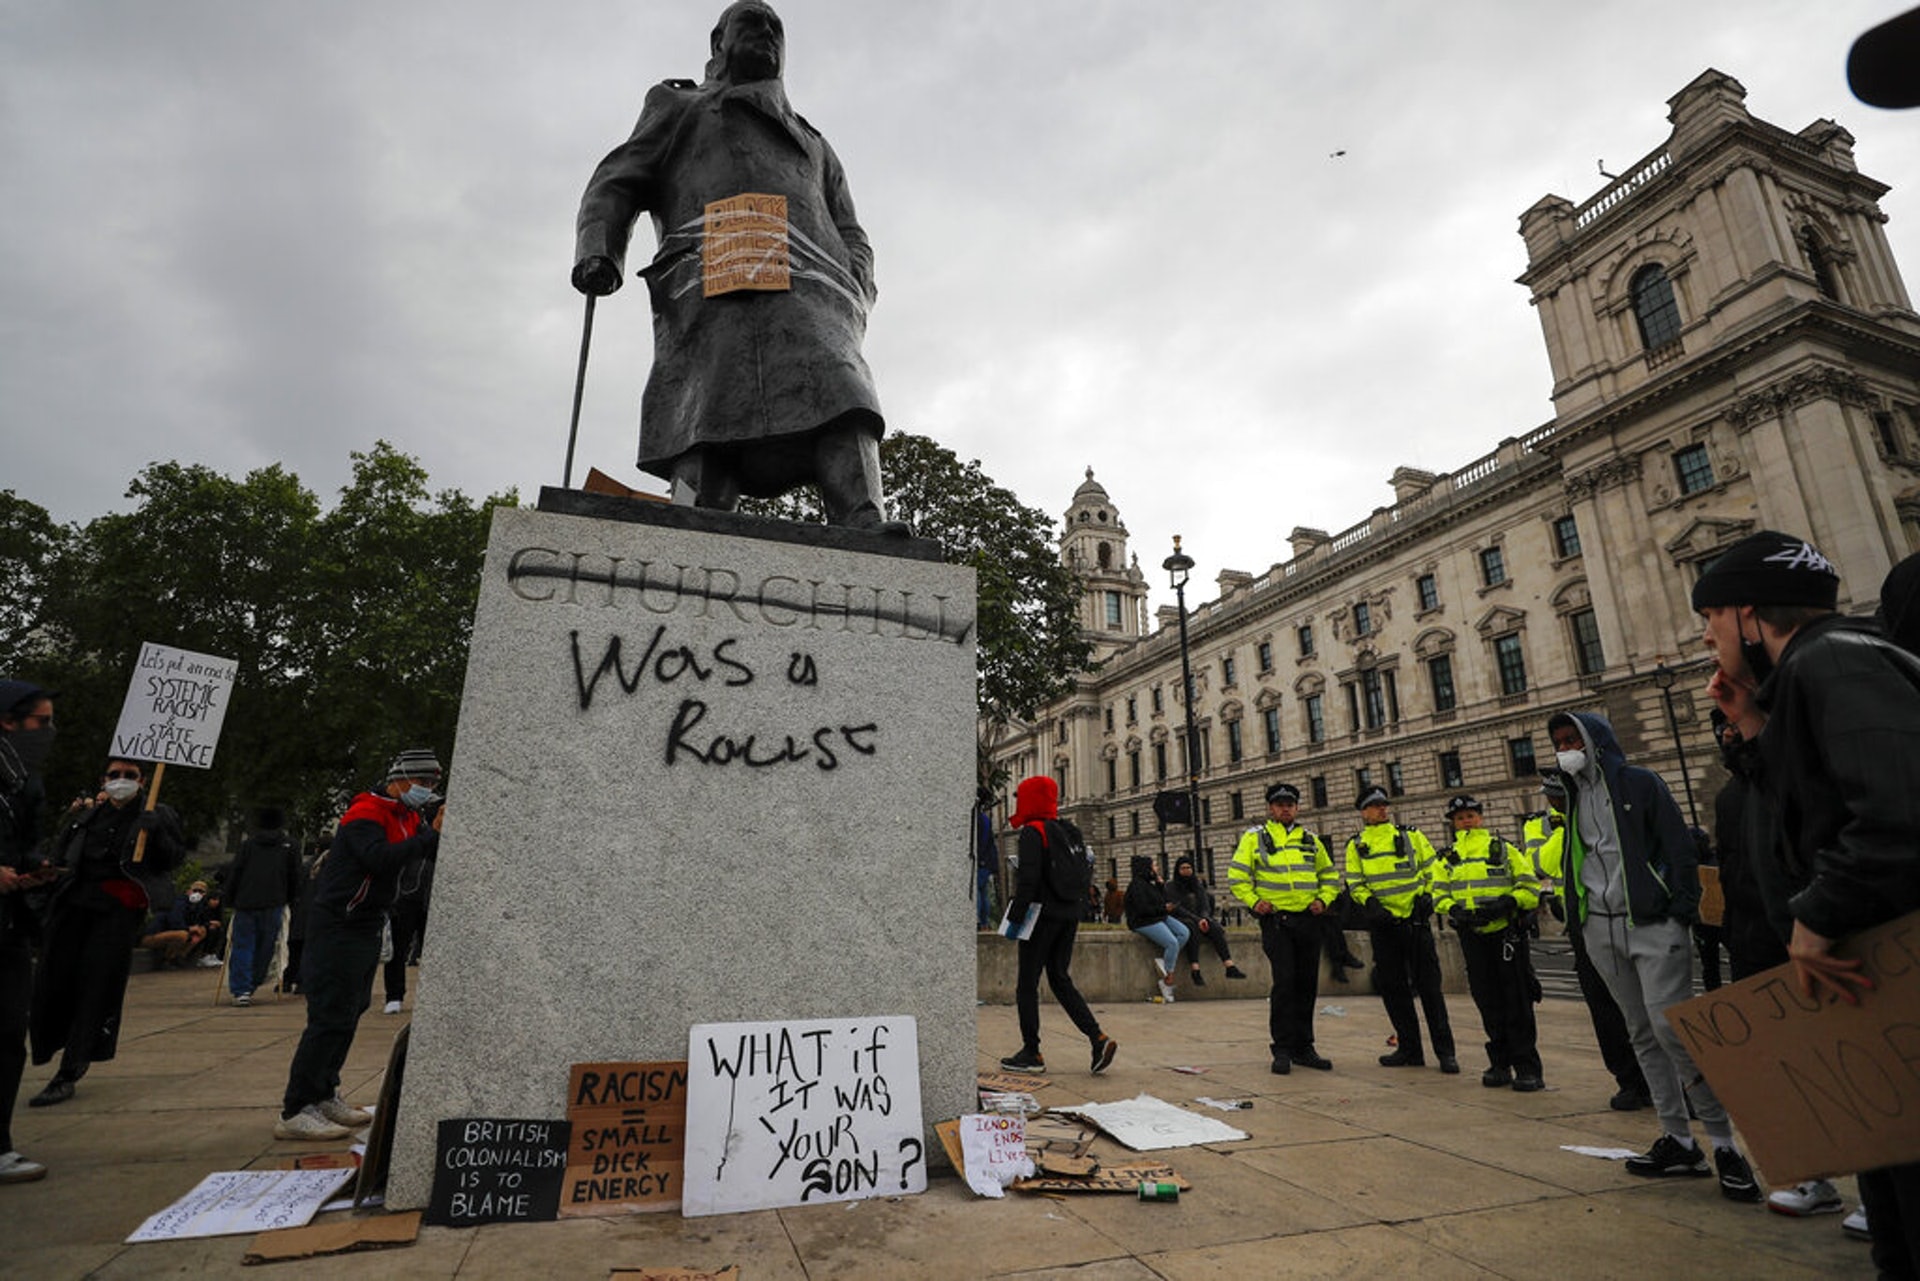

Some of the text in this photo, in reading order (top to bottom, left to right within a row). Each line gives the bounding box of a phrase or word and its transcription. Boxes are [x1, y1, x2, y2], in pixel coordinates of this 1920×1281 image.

[508, 547, 960, 643] CHURCHILL
[570, 626, 818, 711] Was a
[152, 696, 208, 721] RACISM
[147, 723, 195, 744] STATE
[1679, 1000, 1752, 1053] NO
[708, 1027, 832, 1083] WHAT
[769, 1075, 892, 1116] IT WAS
[1779, 1038, 1904, 1146] NO
[463, 1120, 550, 1144] BRITISH
[582, 1125, 673, 1151] SMALL
[758, 1113, 860, 1179] YOUR
[445, 1147, 567, 1169] COLONIALISM
[592, 1151, 650, 1175] DICK
[460, 1171, 522, 1188] IS TO
[571, 1172, 670, 1203] ENERGY
[450, 1192, 530, 1217] BLAME
